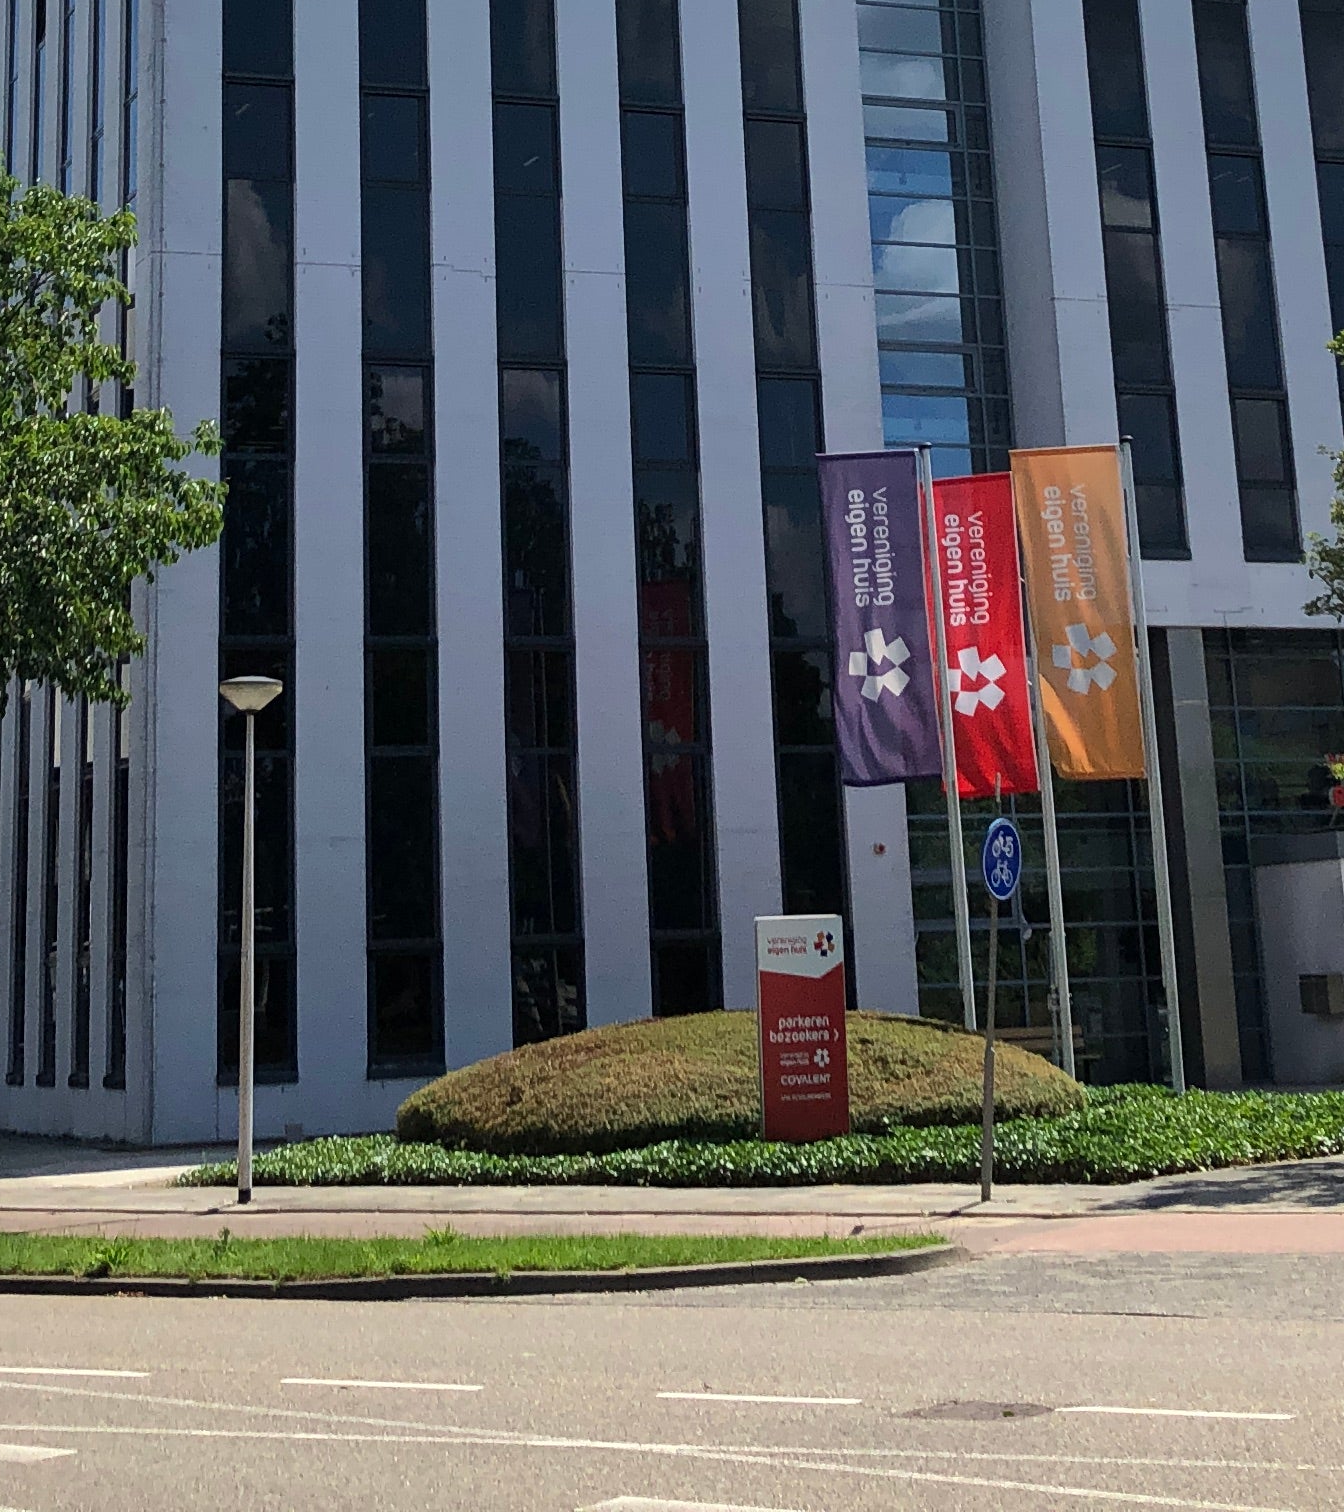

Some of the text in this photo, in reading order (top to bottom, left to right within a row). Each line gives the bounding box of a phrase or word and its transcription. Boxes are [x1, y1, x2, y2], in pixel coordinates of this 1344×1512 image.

[844, 489, 874, 608] eigen huis
[872, 486, 897, 606] vereniging
[941, 514, 971, 627] eigen huis
[968, 510, 993, 625] vereniging
[1040, 486, 1075, 601] eigen huis
[1070, 484, 1097, 600] vereniging
[769, 1028, 830, 1044] bezoekers
[778, 1014, 830, 1031] parkeren
[780, 1073, 831, 1086] COVALENT
